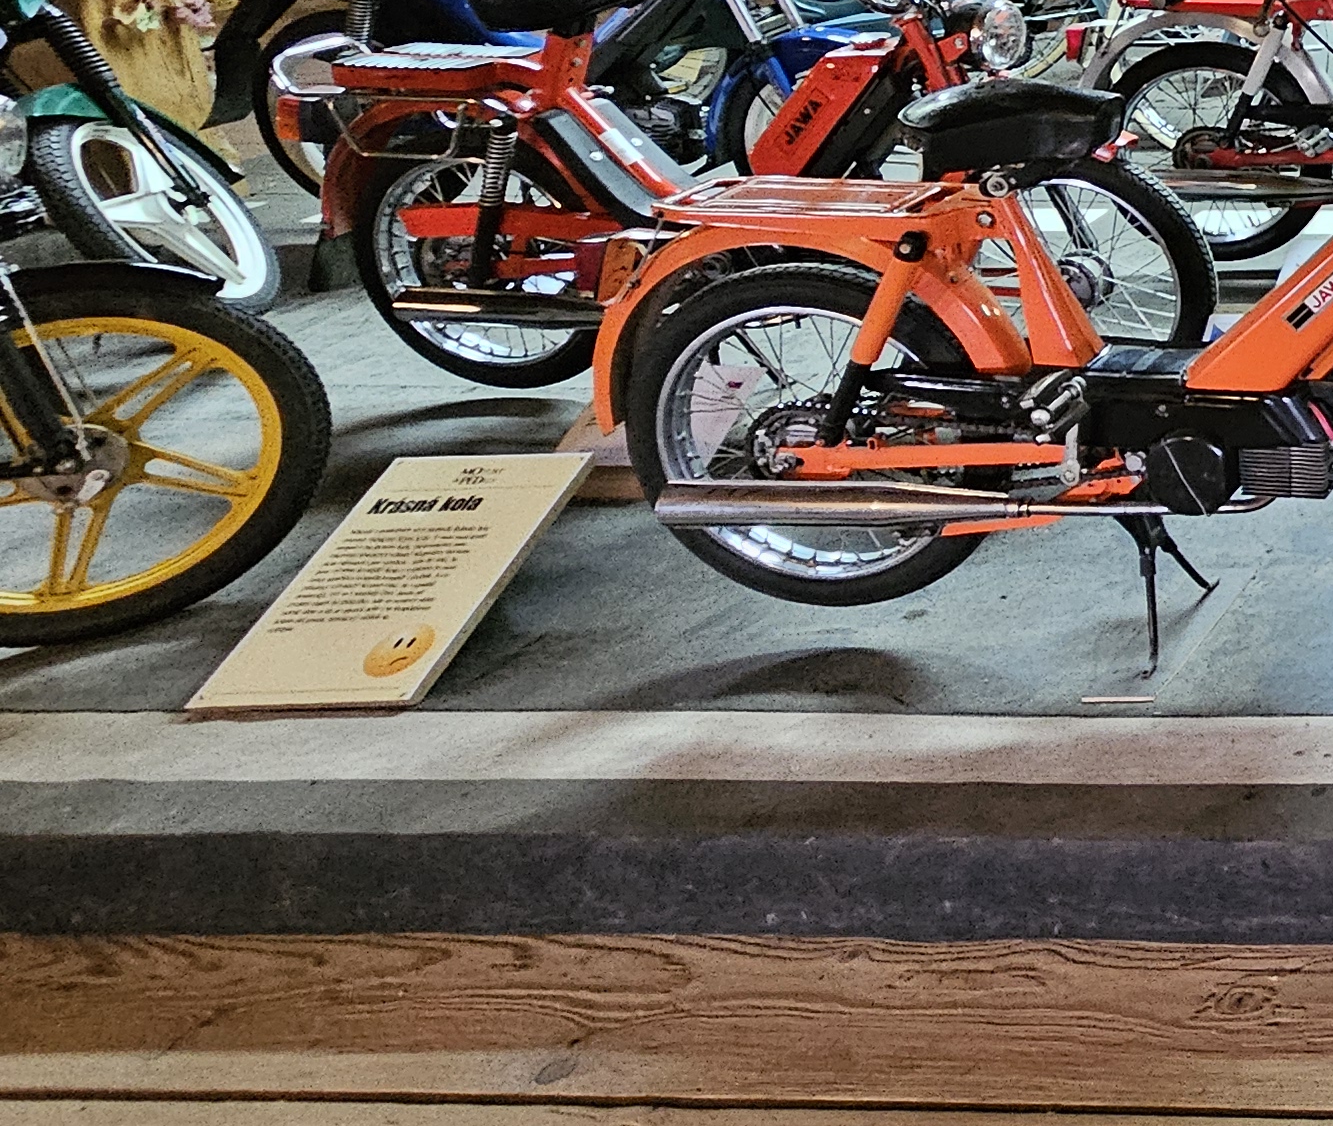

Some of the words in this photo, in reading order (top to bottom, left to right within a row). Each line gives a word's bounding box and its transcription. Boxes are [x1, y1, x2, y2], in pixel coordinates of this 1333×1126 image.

[785, 99, 823, 146] JAWA
[367, 495, 441, 514] Krásná
[438, 495, 484, 513] kola
